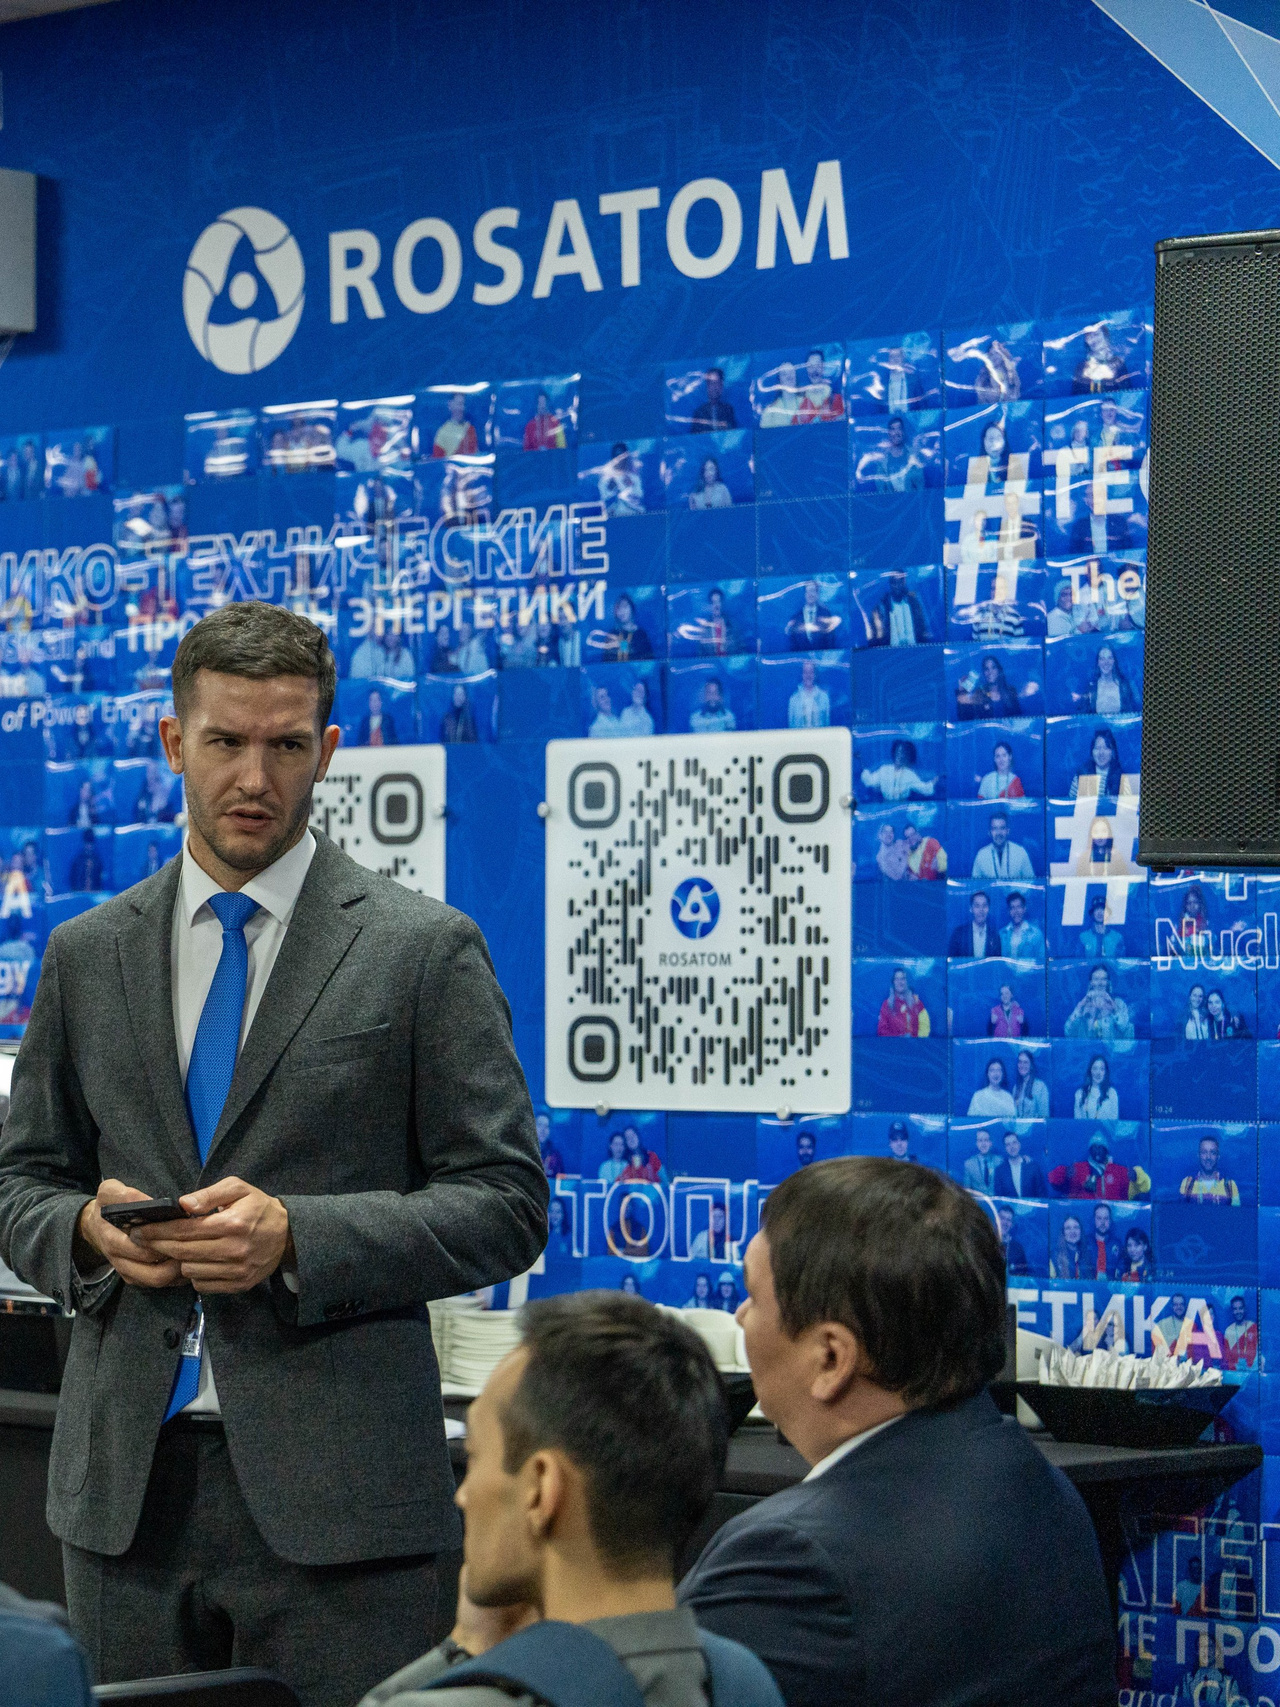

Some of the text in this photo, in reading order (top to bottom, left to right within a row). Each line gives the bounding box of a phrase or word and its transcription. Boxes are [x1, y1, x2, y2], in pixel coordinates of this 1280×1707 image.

[328, 160, 850, 324] ROSATOM
[1042, 445, 1150, 519] ТЕ
[1061, 562, 1146, 605] The
[349, 580, 607, 638] ЭНЕРГЕТИКИ
[1, 702, 28, 733] of
[31, 698, 97, 729] Power
[659, 952, 732, 966] ROSATOM
